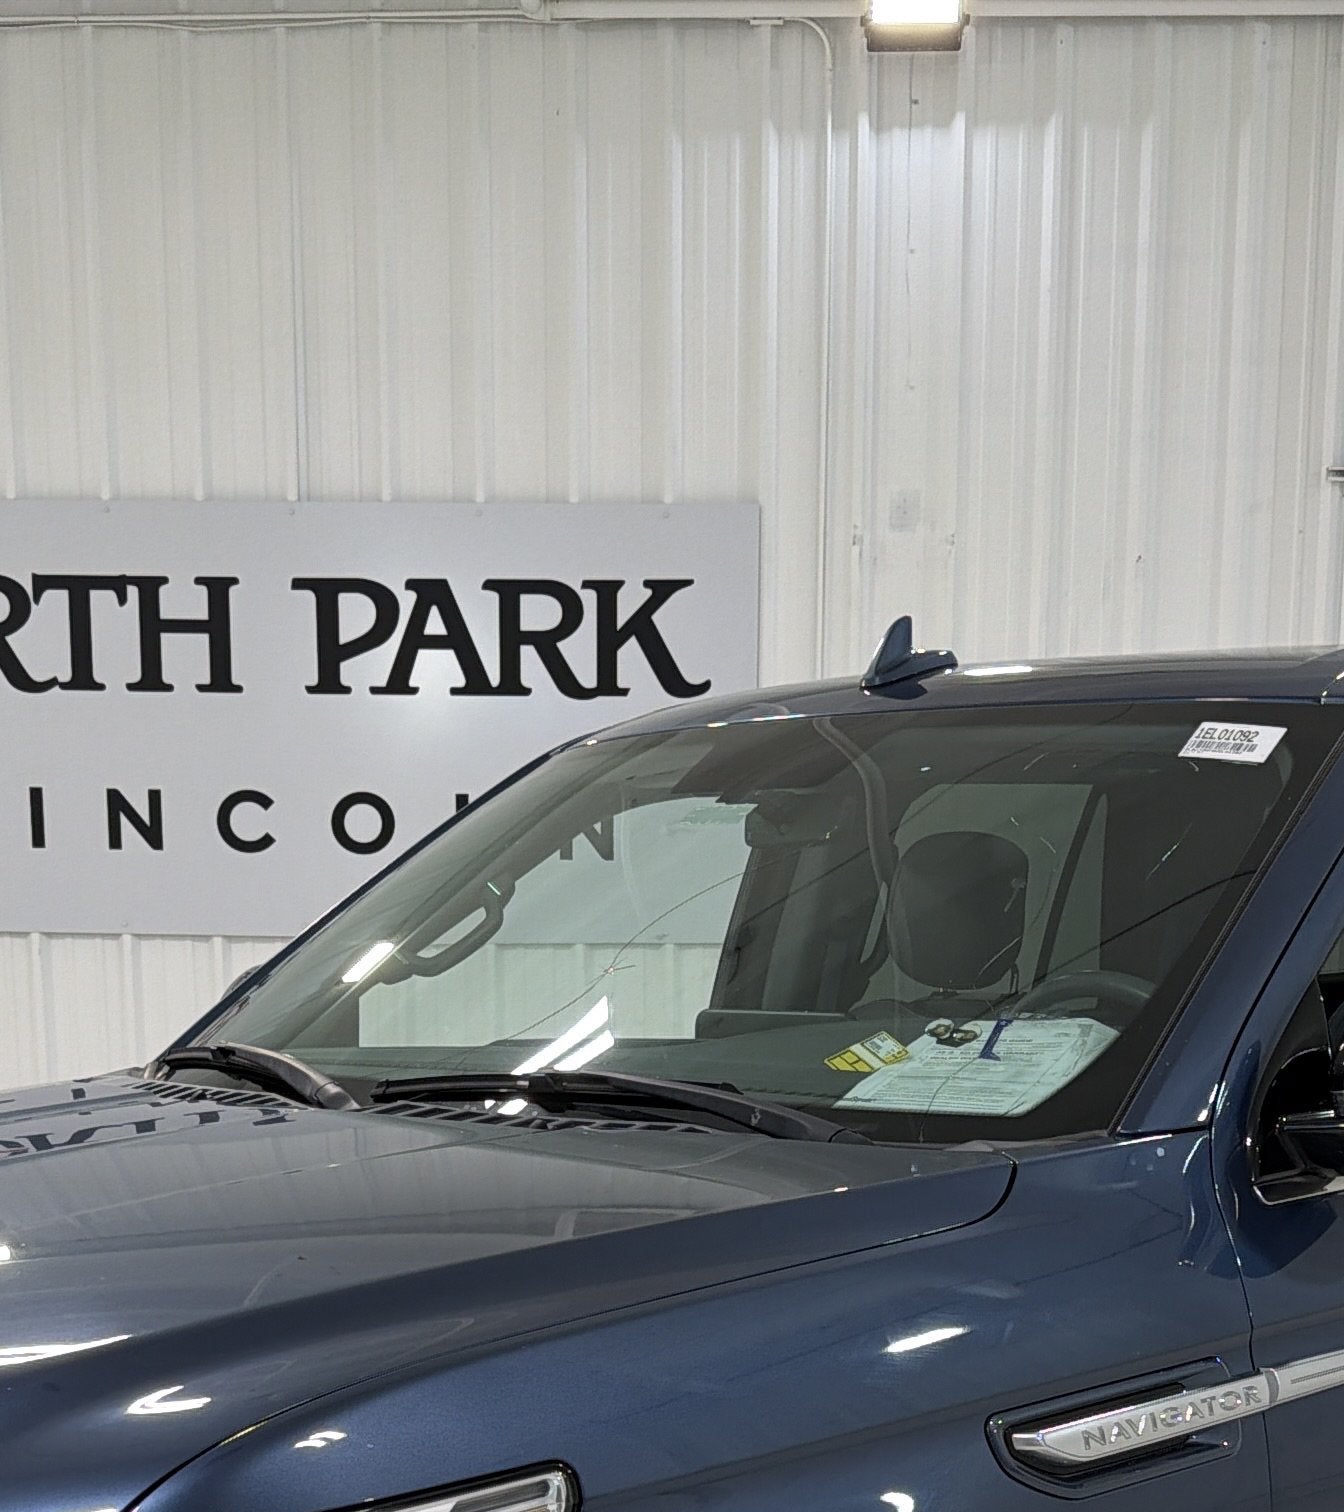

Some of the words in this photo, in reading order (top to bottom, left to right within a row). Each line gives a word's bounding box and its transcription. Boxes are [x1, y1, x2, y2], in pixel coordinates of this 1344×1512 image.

[290, 577, 712, 701] PARK
[1195, 727, 1260, 743] 1EL01092
[1082, 1385, 1262, 1450] NAVIGATOR
